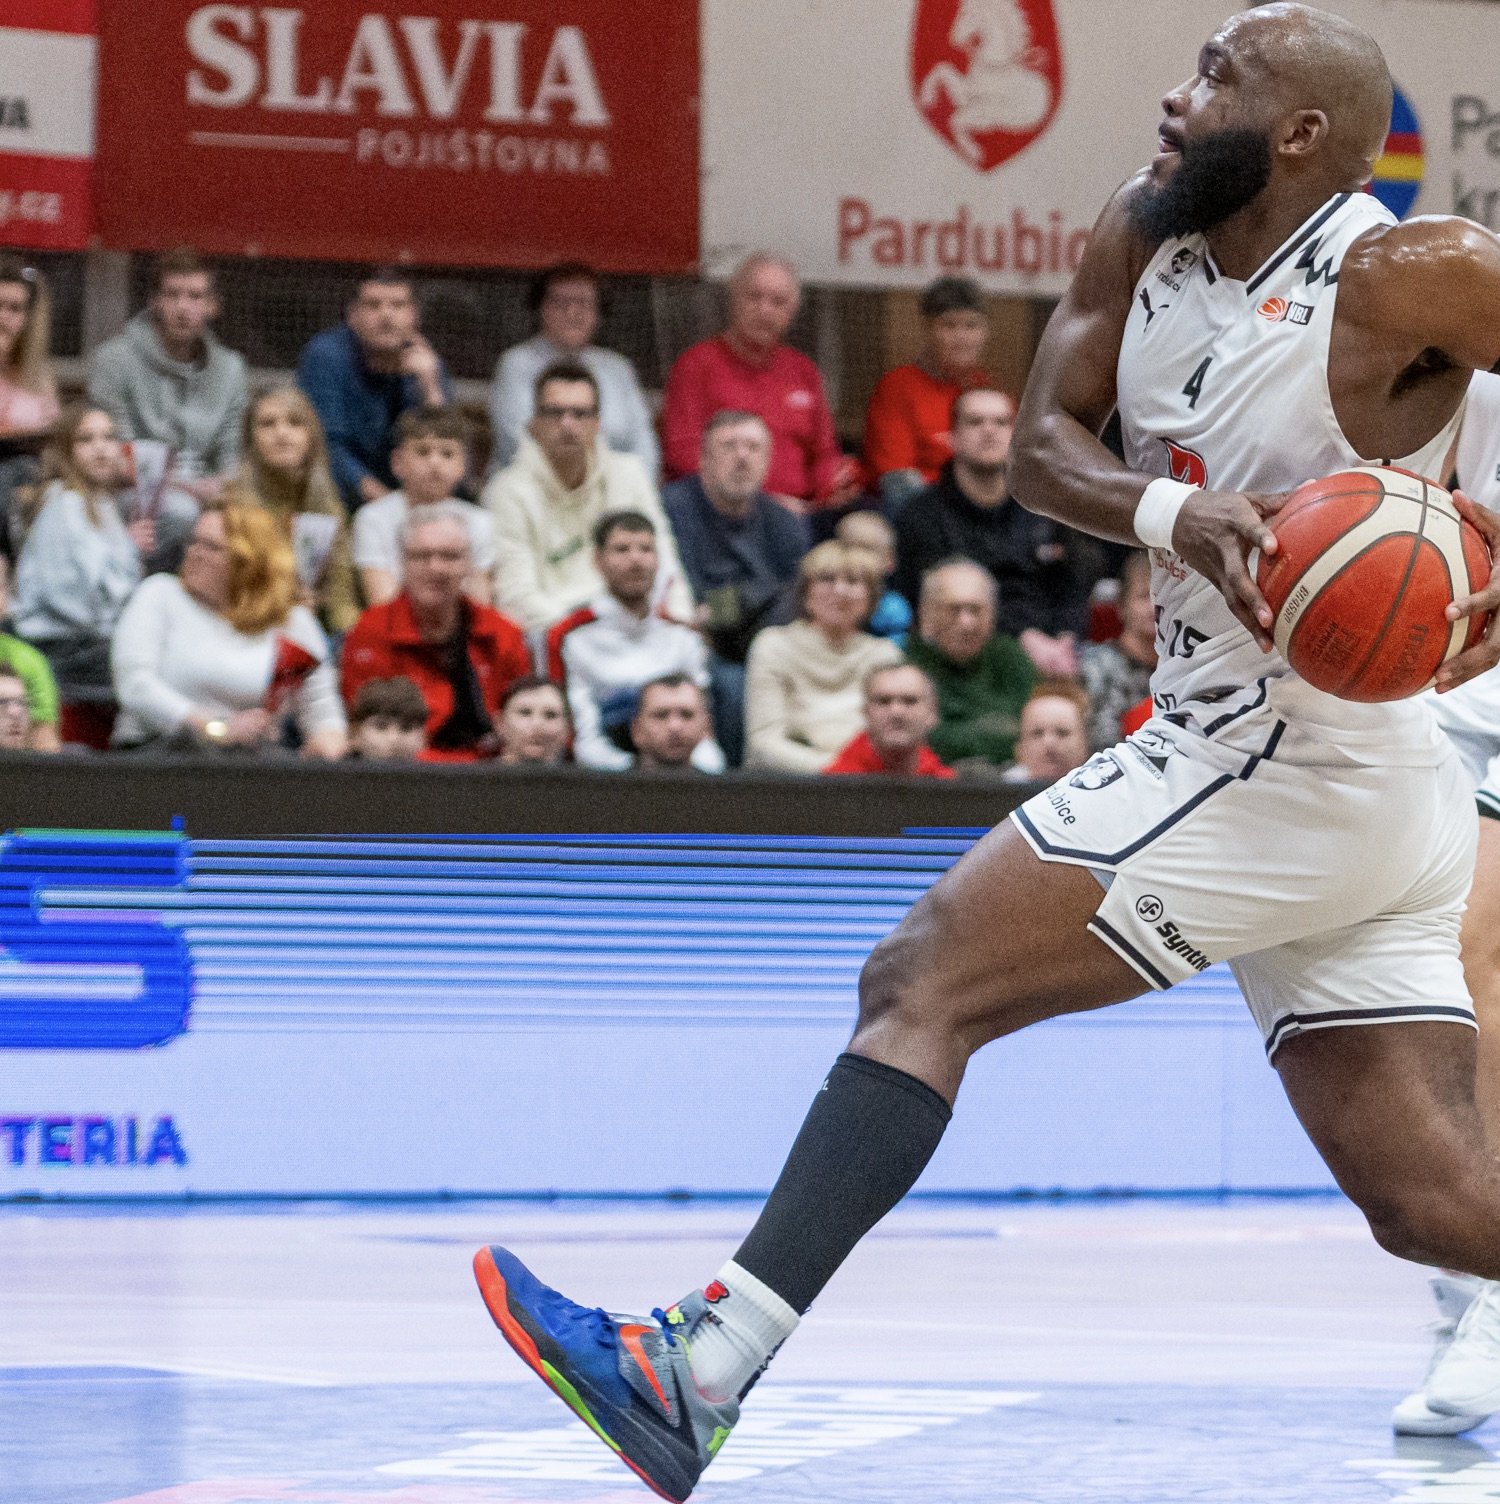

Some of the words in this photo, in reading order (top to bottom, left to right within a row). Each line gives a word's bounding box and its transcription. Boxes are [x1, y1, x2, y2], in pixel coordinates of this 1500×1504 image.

[186, 5, 610, 127] SLAVIA
[837, 196, 1094, 277] Pardubic
[1289, 303, 1308, 324] NBL
[1182, 356, 1213, 410] 4
[0, 1116, 189, 1166] TERIA
